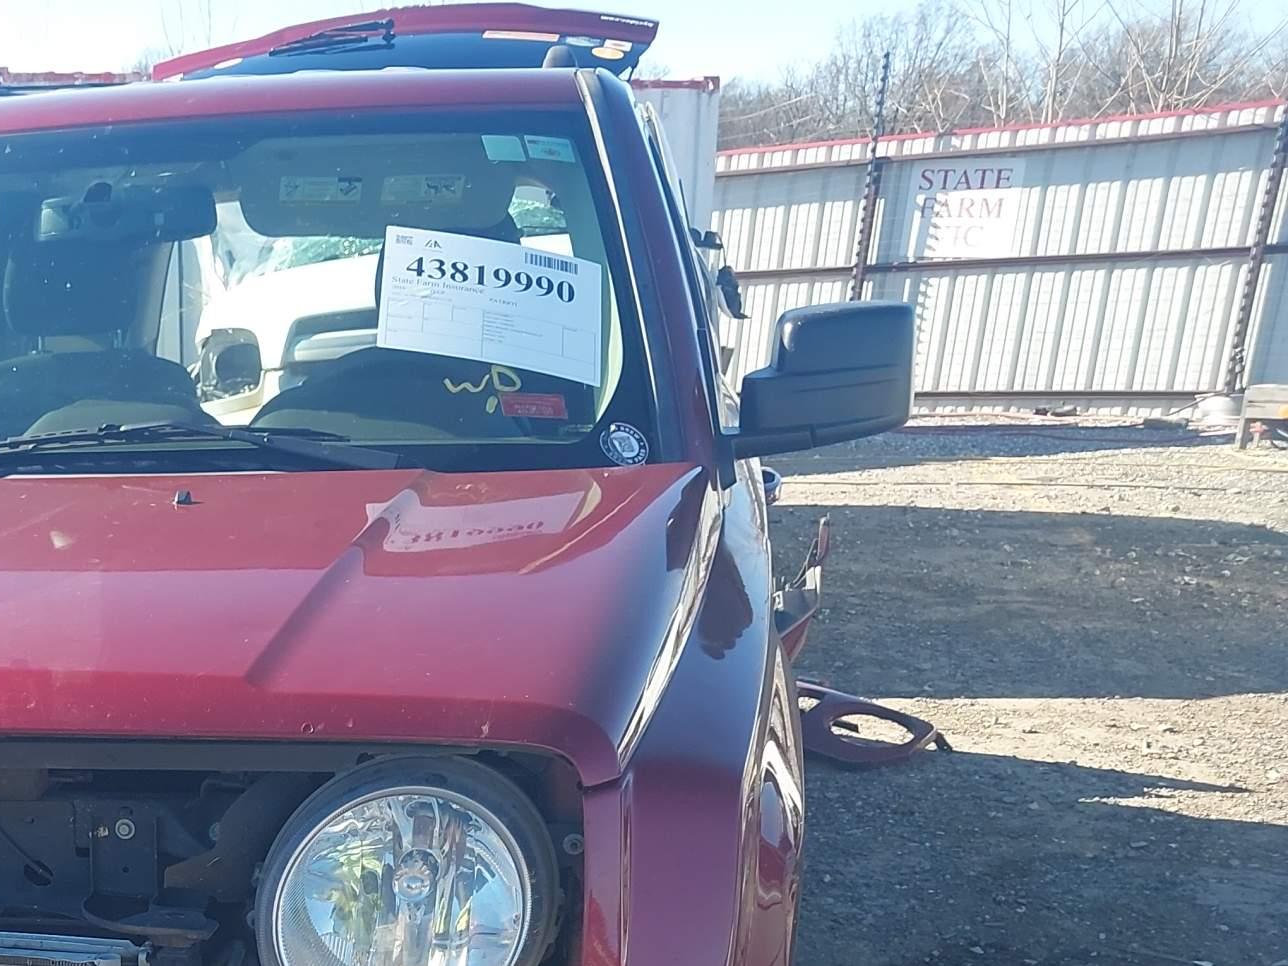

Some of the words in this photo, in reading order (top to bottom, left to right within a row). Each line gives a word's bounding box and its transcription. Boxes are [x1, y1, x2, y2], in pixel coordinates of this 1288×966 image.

[918, 168, 1014, 190] STATE
[920, 197, 1004, 218] FARM
[406, 256, 576, 303] 43819990
